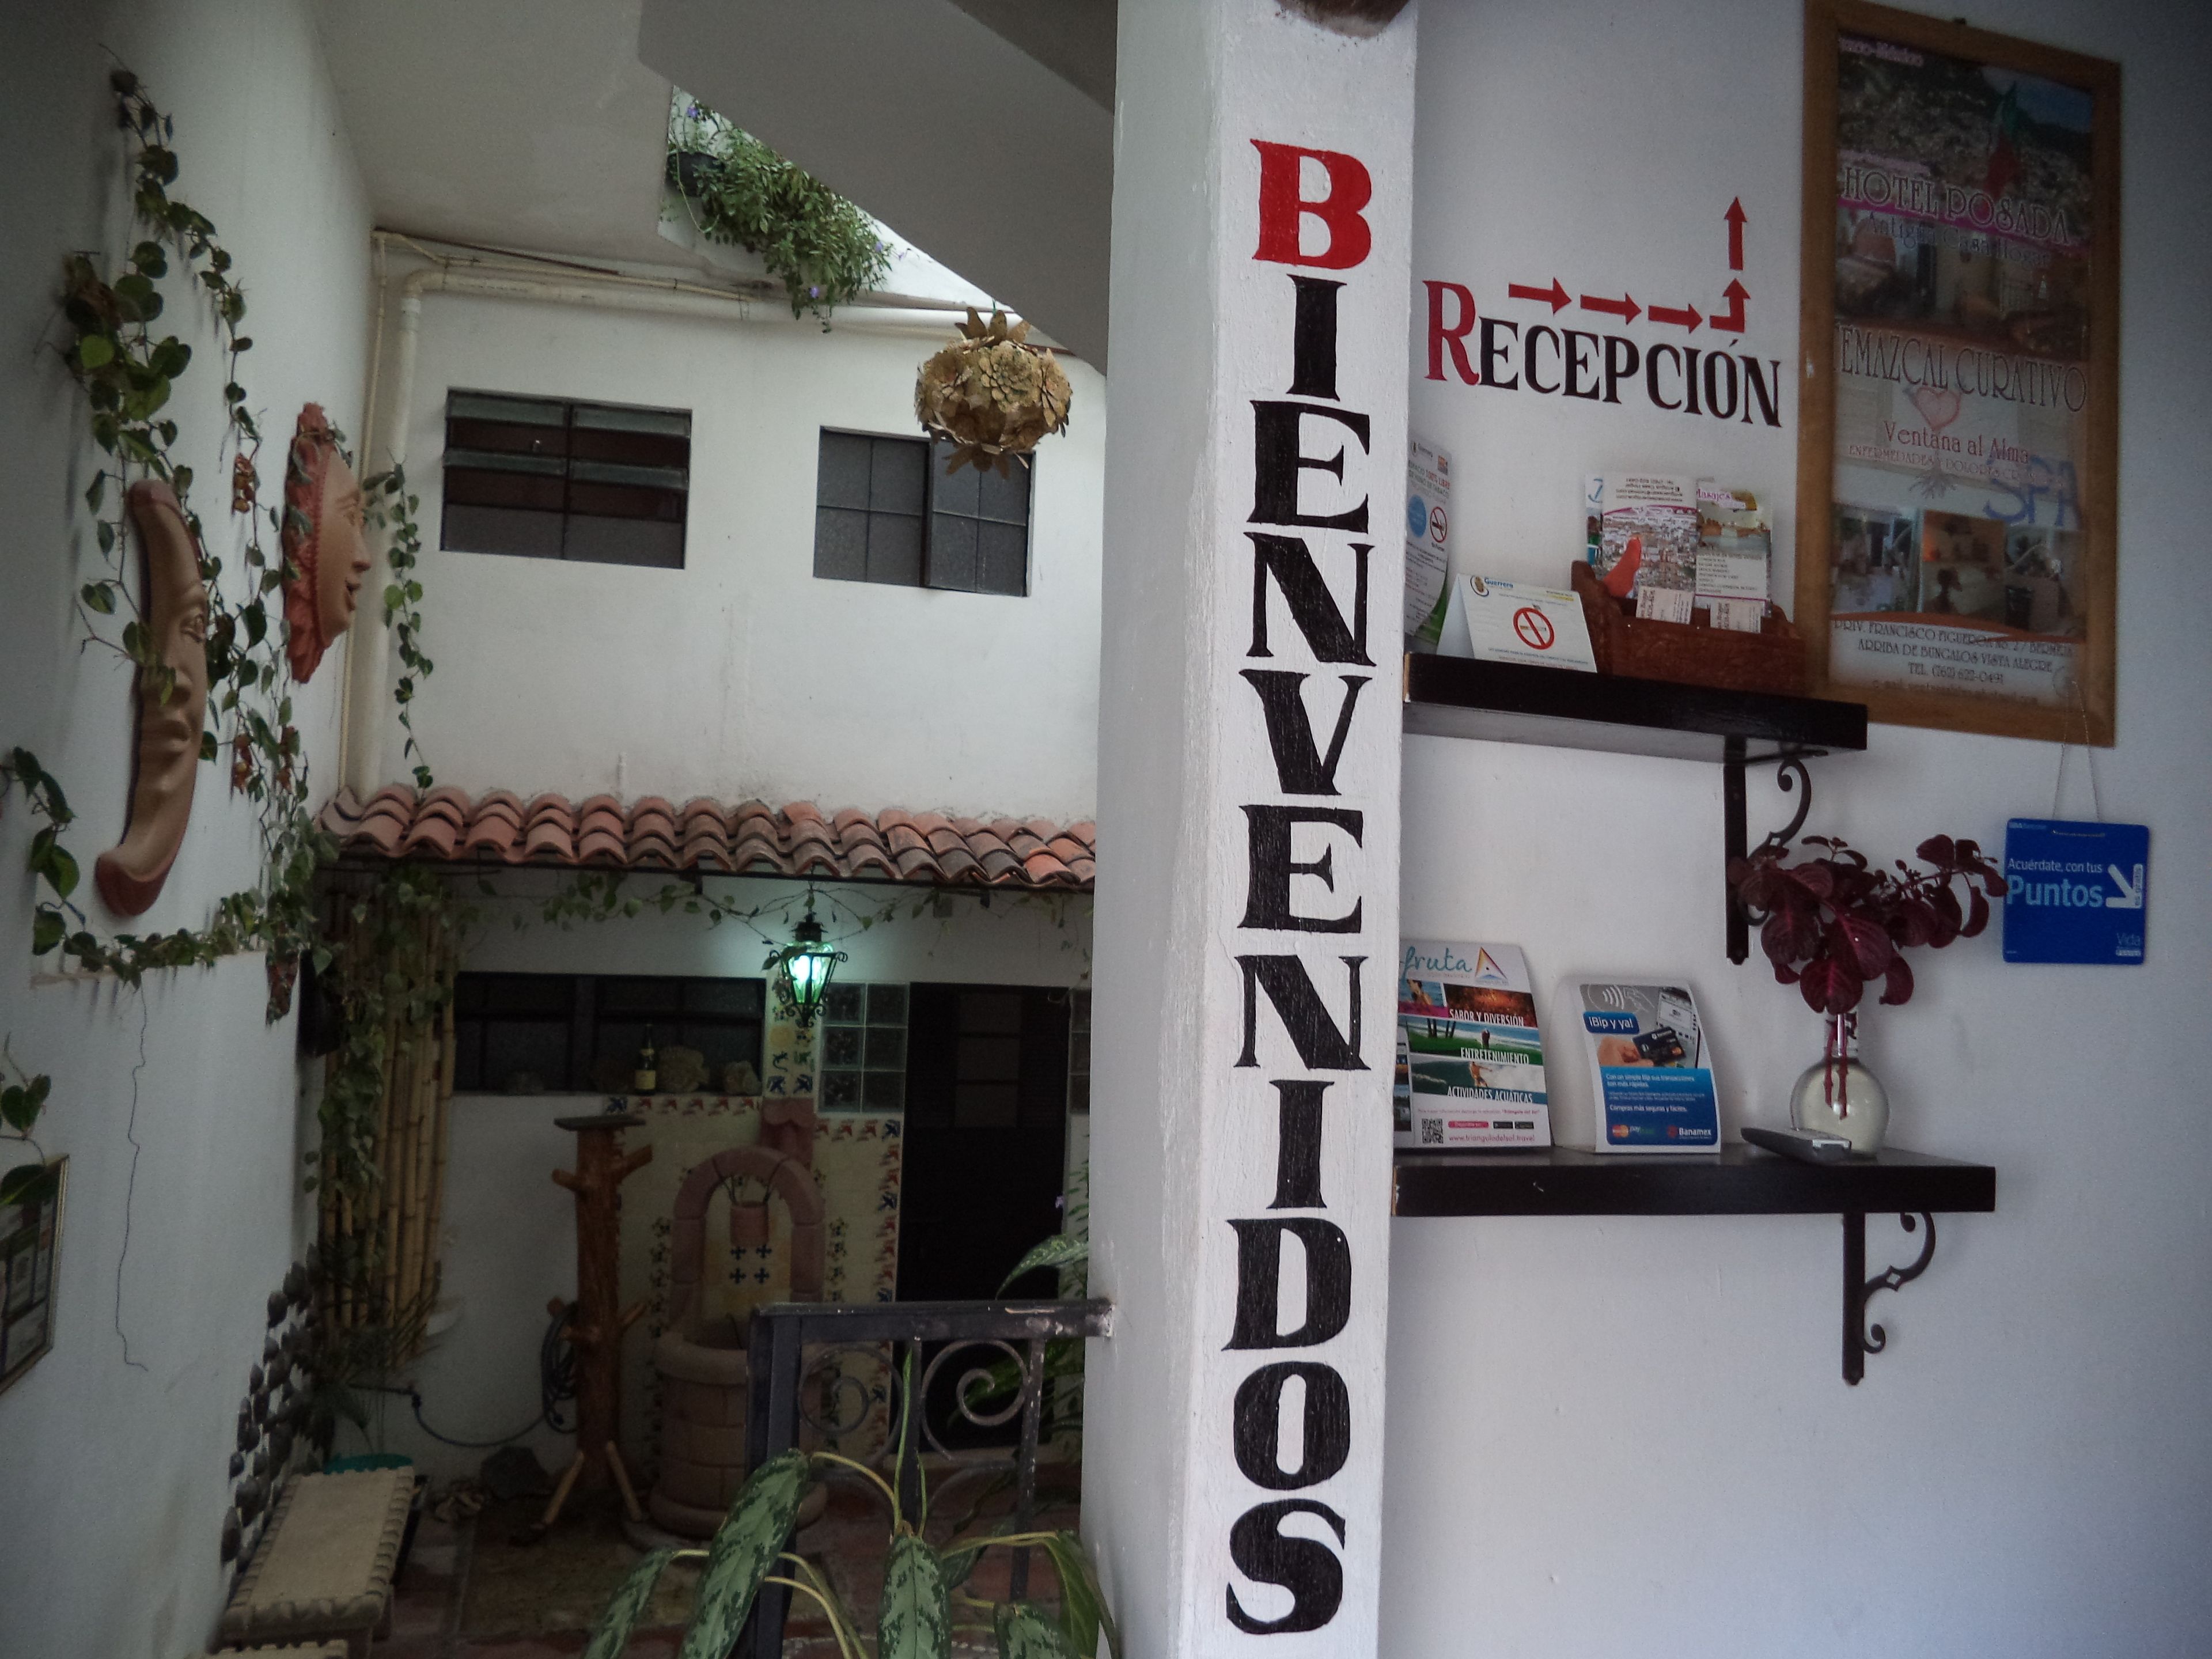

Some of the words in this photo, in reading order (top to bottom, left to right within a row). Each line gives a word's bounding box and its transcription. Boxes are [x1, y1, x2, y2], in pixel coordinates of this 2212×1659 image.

[1843, 166, 1939, 219] HOTEL
[1945, 184, 2070, 246] POSADA
[1422, 279, 1782, 428] RECEPCIÓN
[1836, 324, 1948, 390] EMAZCAL
[1955, 347, 2087, 412] CURATIVO
[1883, 421, 1961, 453] Ventana
[1968, 435, 1983, 457] al
[1991, 437, 2029, 465] Alma
[1484, 577, 1514, 589] Guerrero
[1869, 622, 1936, 641] FRANCISCO
[1858, 638, 1899, 654] ARRIBA
[1903, 643, 1918, 657] DE
[2065, 863, 2085, 873] con
[2086, 861, 2103, 874] tus
[1221, 138, 1376, 1636] BIENVENIDOS
[2006, 874, 2104, 908] Puntos
[1449, 1008, 1475, 1022] SABOR
[1476, 1012, 1482, 1023] Y
[1483, 1013, 1524, 1027] DIVERSIÓN
[1609, 1019, 1616, 1030] y
[1460, 1047, 1530, 1065] ENTRETENIMIENTO
[1447, 1086, 1493, 1100] ACTIVIDADES
[1495, 1089, 1533, 1104] ACUÁTICAS
[1679, 1127, 1712, 1137] Banamex
